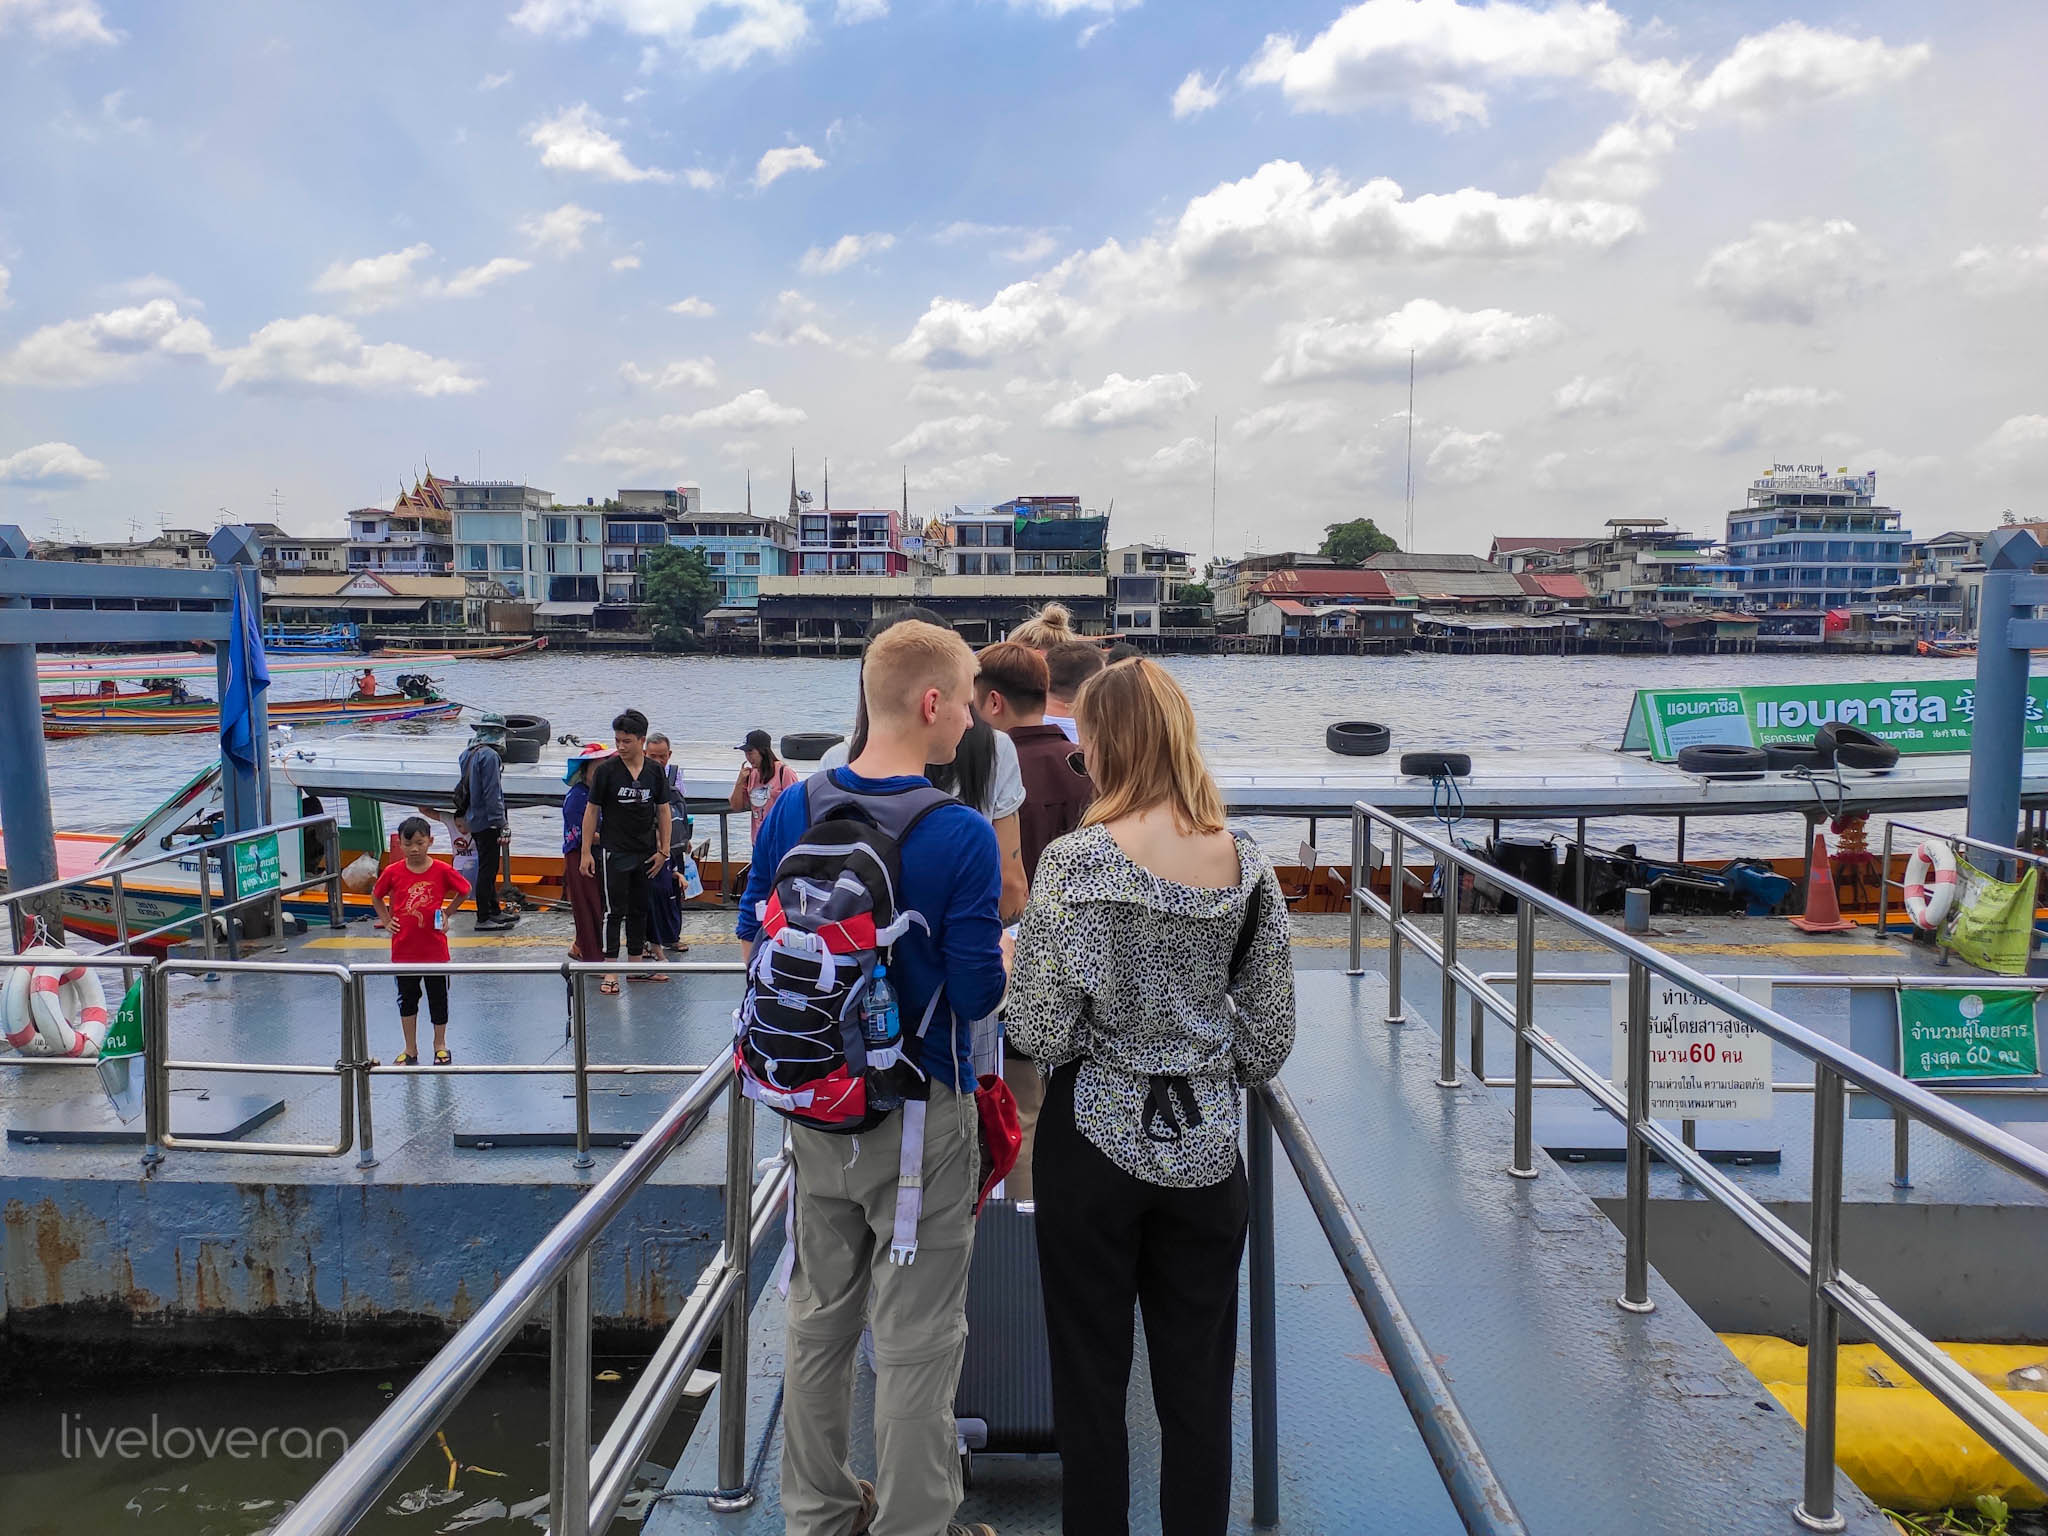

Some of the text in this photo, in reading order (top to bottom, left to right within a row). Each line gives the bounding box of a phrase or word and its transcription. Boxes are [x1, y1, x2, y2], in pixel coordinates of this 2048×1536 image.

[1774, 464, 1823, 472] RIVA ARUN
[107, 1035, 127, 1048] คน
[1911, 1020, 2028, 1045] จำนวนผู้โดยสาร
[1690, 1043, 1716, 1063] 60
[1722, 1050, 1743, 1063] คน
[1920, 1046, 2020, 1071] สูงสุด 60 คน
